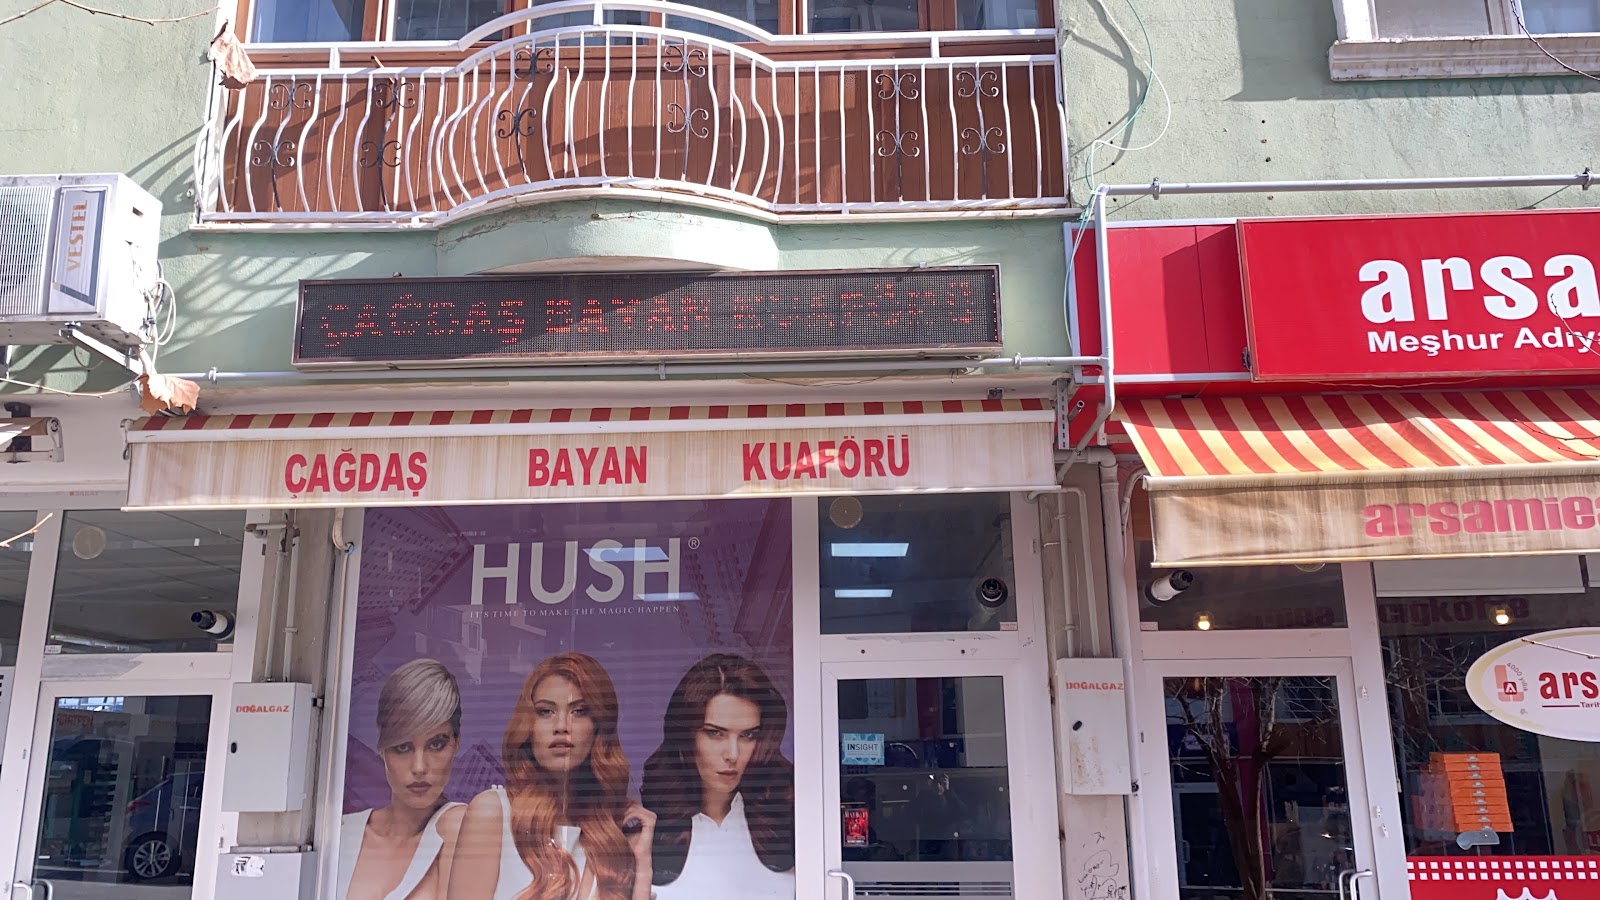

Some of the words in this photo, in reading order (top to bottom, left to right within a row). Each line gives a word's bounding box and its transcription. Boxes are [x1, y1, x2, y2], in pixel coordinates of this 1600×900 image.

[66, 200, 87, 272] VESTEL
[546, 297, 711, 332] BAYAN
[1367, 329, 1504, 357] Meşhur
[1514, 326, 1600, 353] Adıy
[284, 447, 428, 498] ÇAĞDAŞ
[528, 445, 648, 487] BAYAN
[742, 434, 910, 482] KUAFÖRÜ
[1363, 496, 1600, 538] arsamie
[470, 537, 681, 605] HUSH
[469, 610, 489, 619] IT'S
[492, 609, 519, 618] TIME
[522, 609, 537, 617] TO
[539, 608, 570, 617] MAKE
[574, 607, 595, 616] THE
[599, 606, 634, 615] MAGIC
[637, 605, 680, 614] HAPPEN
[1506, 662, 1523, 676] 4000
[1065, 681, 1124, 691] DOĞALGAZ
[235, 704, 290, 713] DOĞALGAZ
[847, 743, 879, 751] INSIGHT
